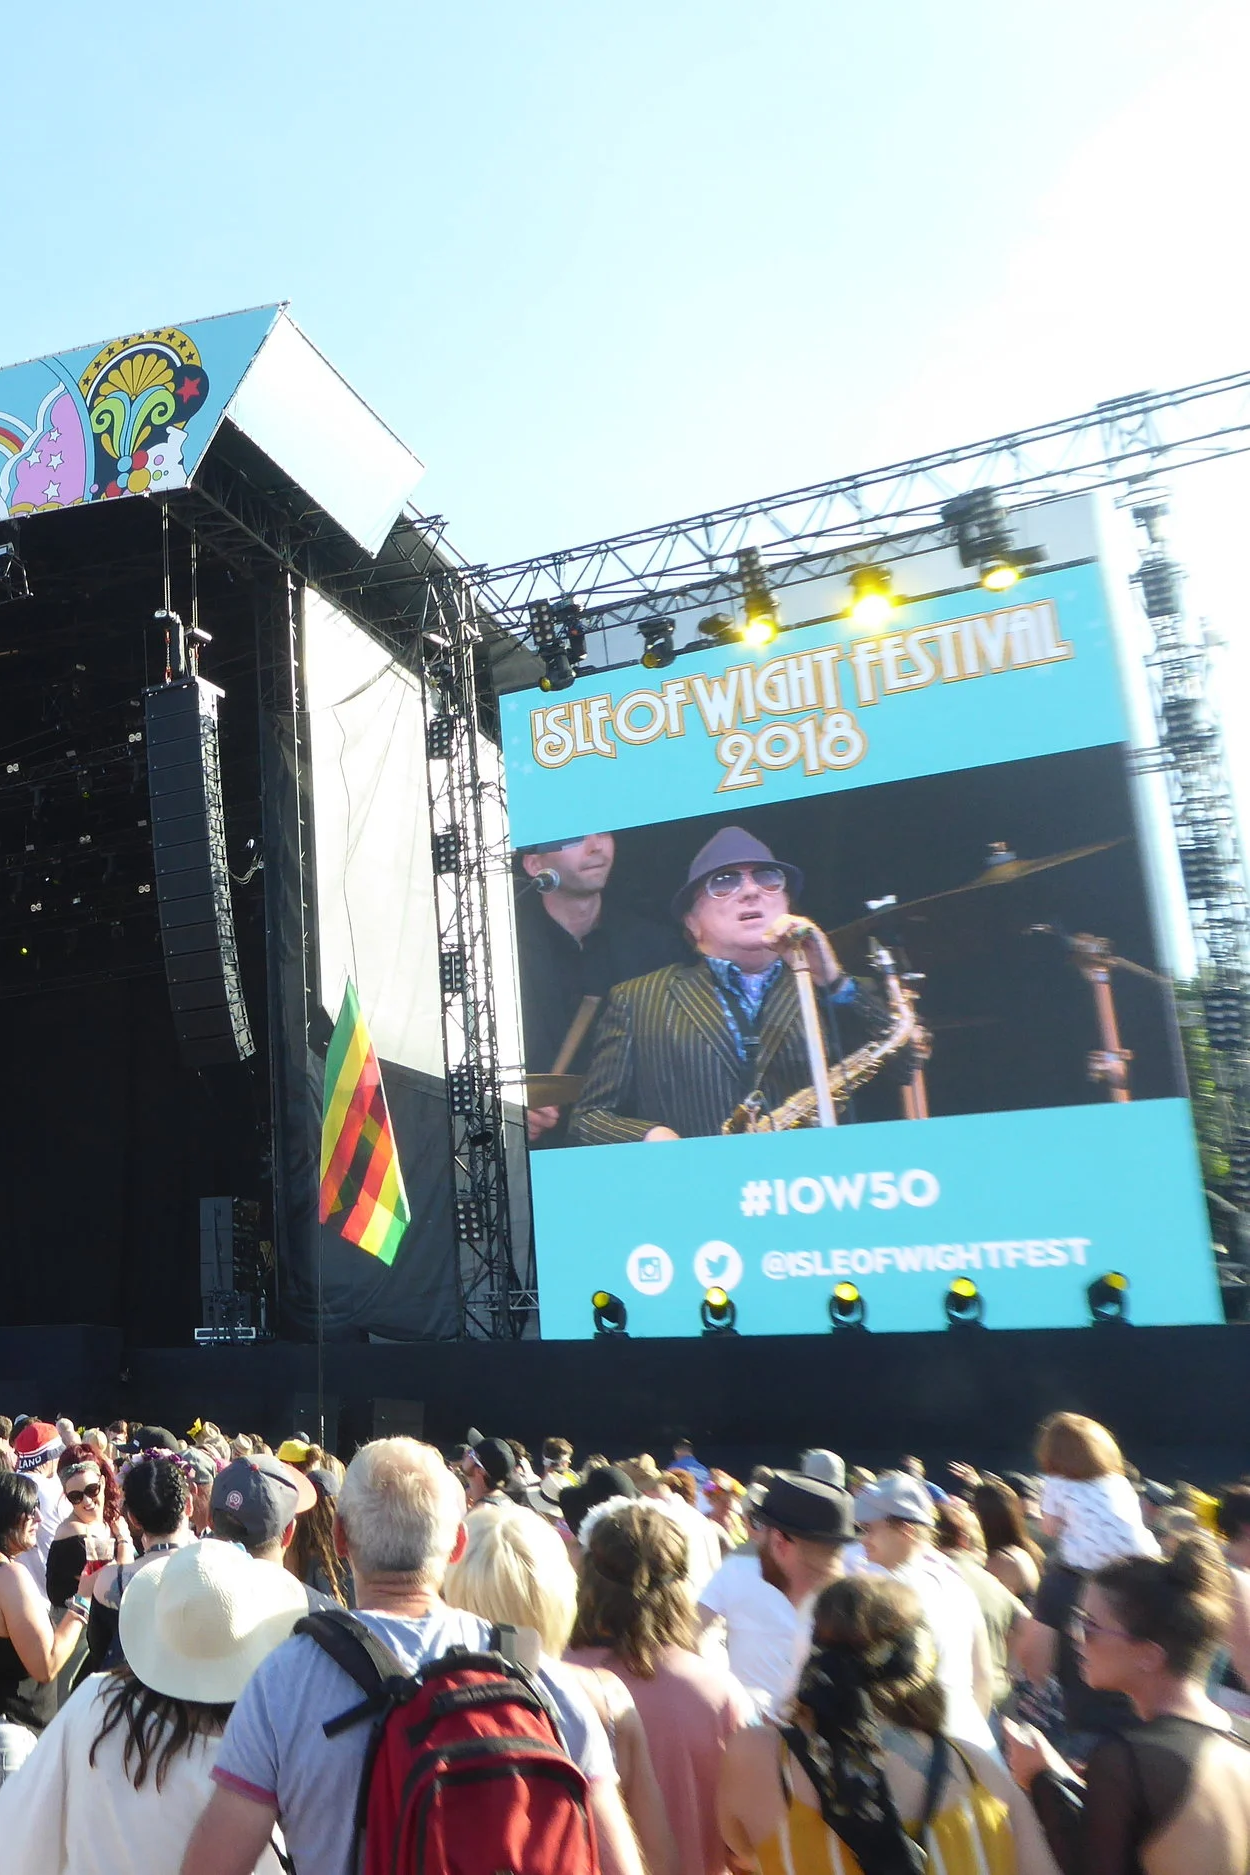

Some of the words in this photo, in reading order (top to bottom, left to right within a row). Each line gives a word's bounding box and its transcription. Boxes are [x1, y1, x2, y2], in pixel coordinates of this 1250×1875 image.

[530, 693, 617, 768] ISLE
[613, 675, 692, 744] OF
[691, 643, 843, 736] WIGHT
[846, 597, 1075, 707] FESTIVAL
[714, 708, 867, 793] 2018
[740, 1169, 940, 1217] #IOW50
[761, 1237, 1091, 1280] @ISLEOFWIGHTFEST
